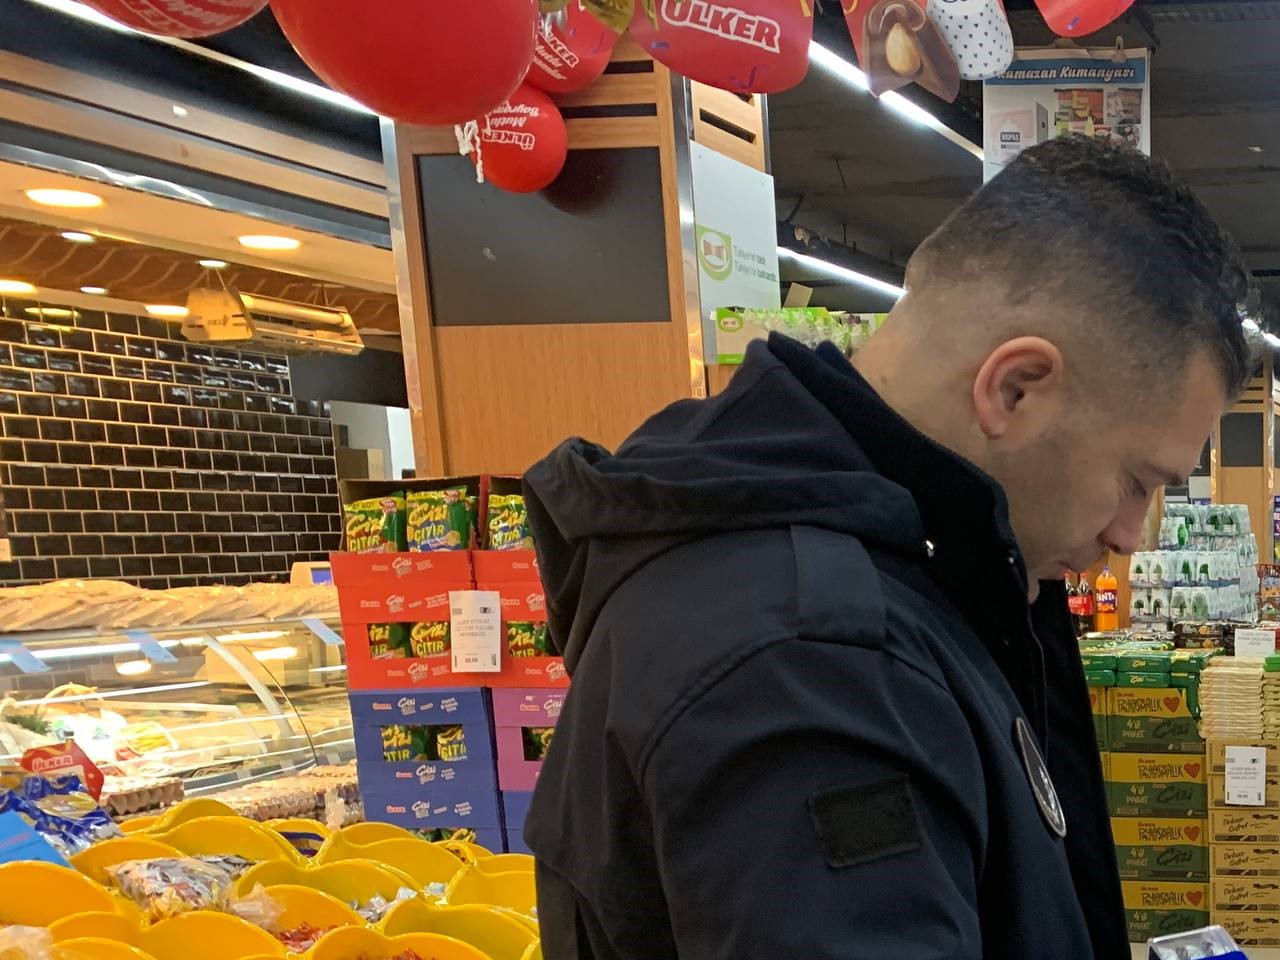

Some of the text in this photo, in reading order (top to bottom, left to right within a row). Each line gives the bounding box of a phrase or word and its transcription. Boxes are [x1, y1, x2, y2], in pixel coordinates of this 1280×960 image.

[661, 0, 780, 53] ÜLKER
[1060, 65, 1136, 82] Kumanyası
[370, 624, 390, 642] izi
